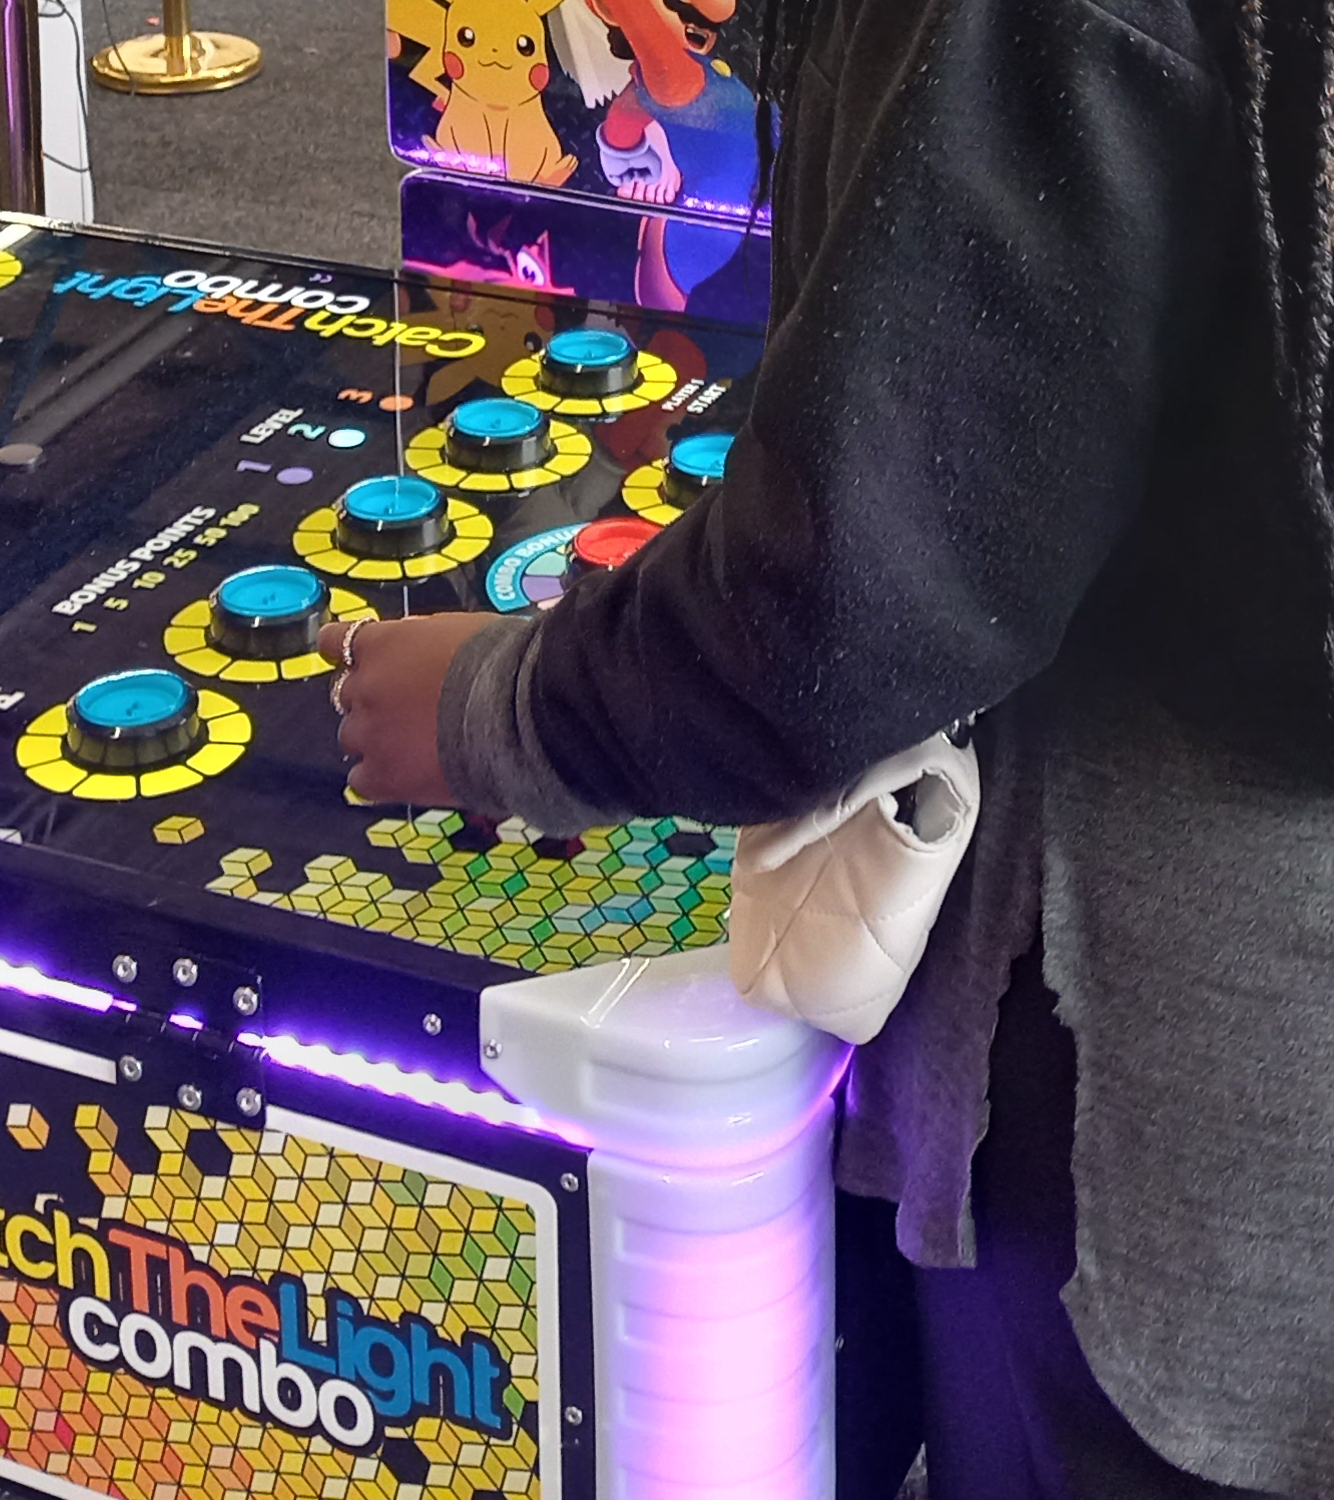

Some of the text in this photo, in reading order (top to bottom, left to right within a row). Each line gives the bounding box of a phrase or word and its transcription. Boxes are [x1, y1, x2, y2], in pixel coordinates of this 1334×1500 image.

[163, 270, 370, 315] combo
[337, 388, 374, 404] 3
[687, 383, 727, 414] START
[240, 408, 304, 444] LEVEL
[287, 423, 327, 440] 2
[236, 460, 273, 473] 1
[51, 505, 217, 616] BONUS POINTS
[132, 570, 166, 589] 10
[162, 547, 199, 569] 25
[193, 527, 228, 547] 50
[218, 503, 261, 527] 100
[494, 556, 523, 600] COMBO
[69, 1297, 375, 1447] combo
